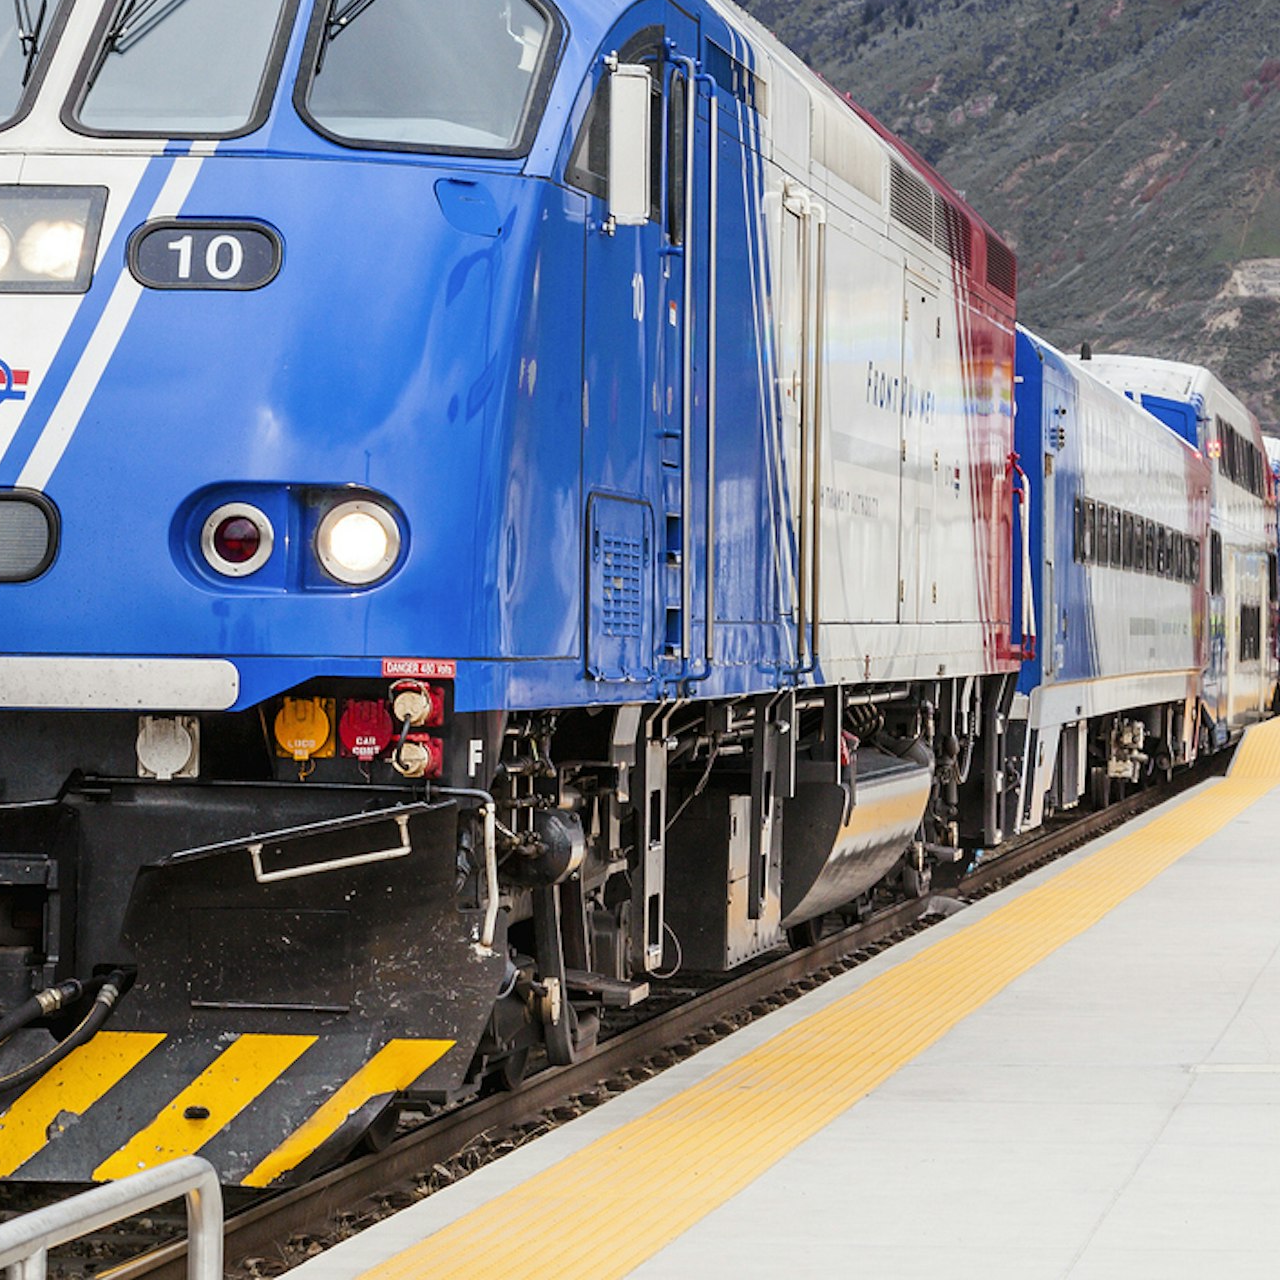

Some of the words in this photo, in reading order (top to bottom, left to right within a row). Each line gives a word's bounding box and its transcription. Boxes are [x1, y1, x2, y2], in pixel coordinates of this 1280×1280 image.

[168, 234, 244, 280] 10
[632, 272, 646, 322] 10
[387, 662, 419, 673] DANGER
[352, 745, 380, 755] CONT
[355, 736, 376, 746] CAR
[468, 739, 483, 777] F
